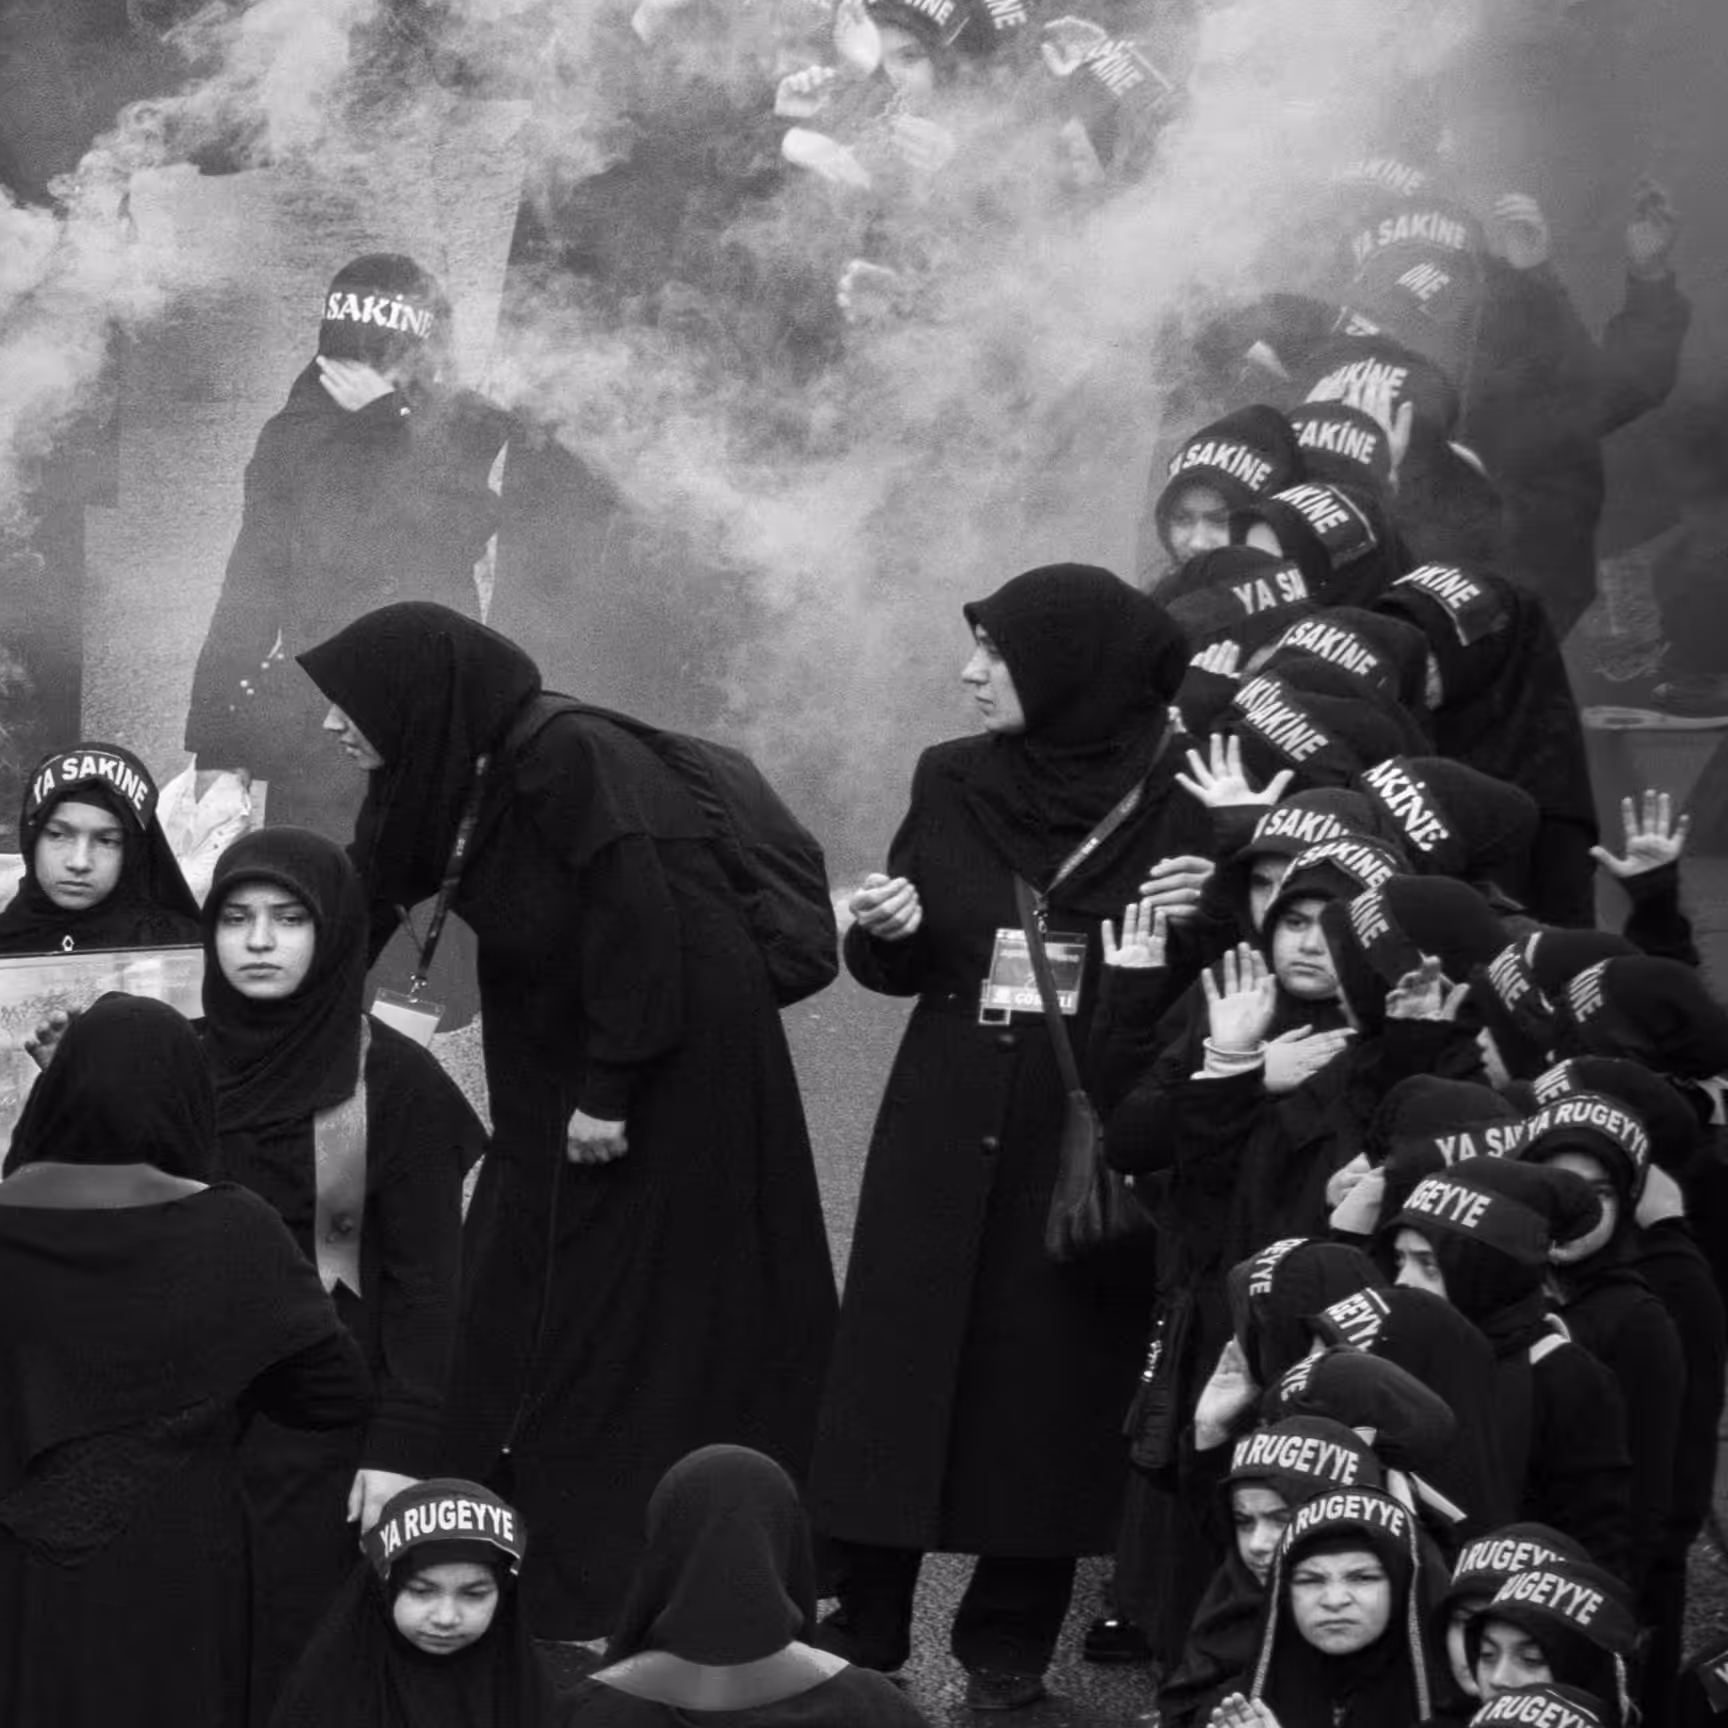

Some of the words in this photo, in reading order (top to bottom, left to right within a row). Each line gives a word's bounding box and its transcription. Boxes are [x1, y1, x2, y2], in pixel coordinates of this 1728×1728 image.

[1231, 578, 1277, 615] YA
[33, 767, 55, 804] YA
[1435, 1132, 1478, 1168] YA
[1555, 1100, 1650, 1166] RUGEYYE
[1246, 1432, 1360, 1487] RUGEYYE
[380, 1522, 402, 1557] YA
[405, 1499, 515, 1542] RUGEYYE
[1296, 1493, 1406, 1538] RUGEYYE
